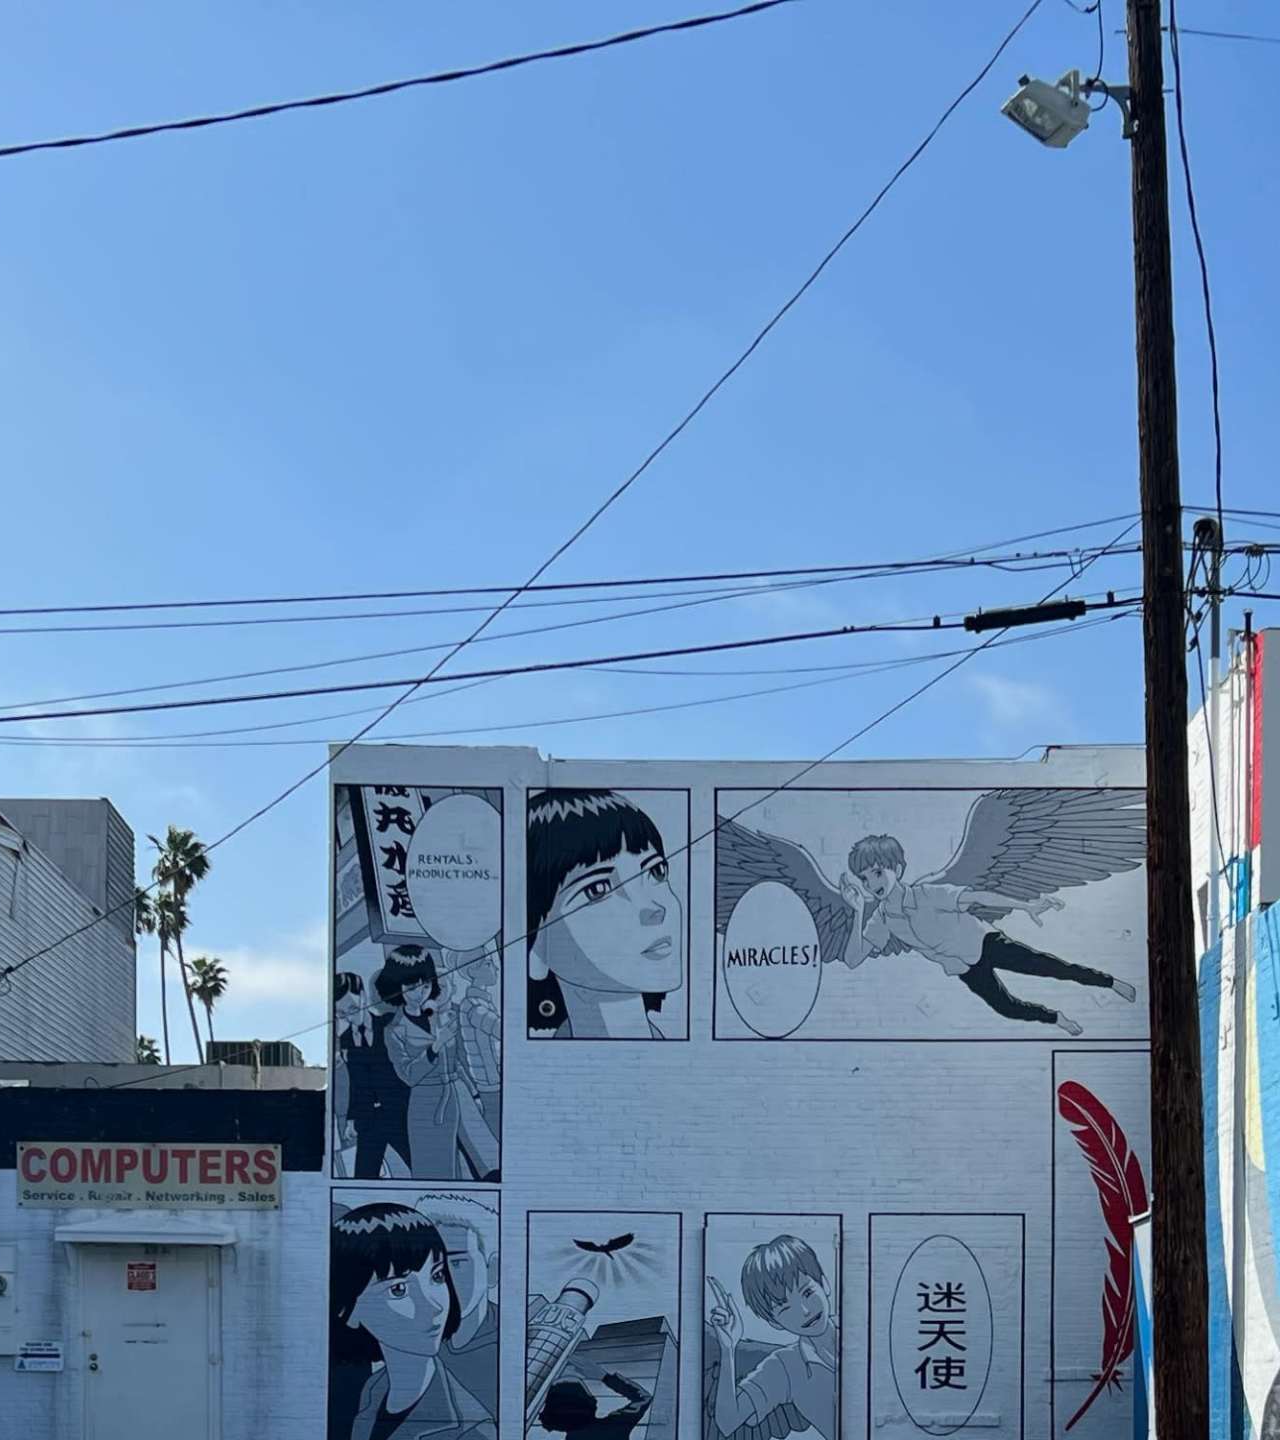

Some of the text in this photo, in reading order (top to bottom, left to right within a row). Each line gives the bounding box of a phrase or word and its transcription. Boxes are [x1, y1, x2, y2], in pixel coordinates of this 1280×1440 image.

[727, 944, 818, 968] MIRACLES!
[21, 1147, 278, 1185] COMPUTERS
[22, 1190, 75, 1201] Service
[145, 1191, 225, 1204] Networking
[238, 1191, 275, 1202] Sales
[914, 1282, 968, 1390] 迷天使
